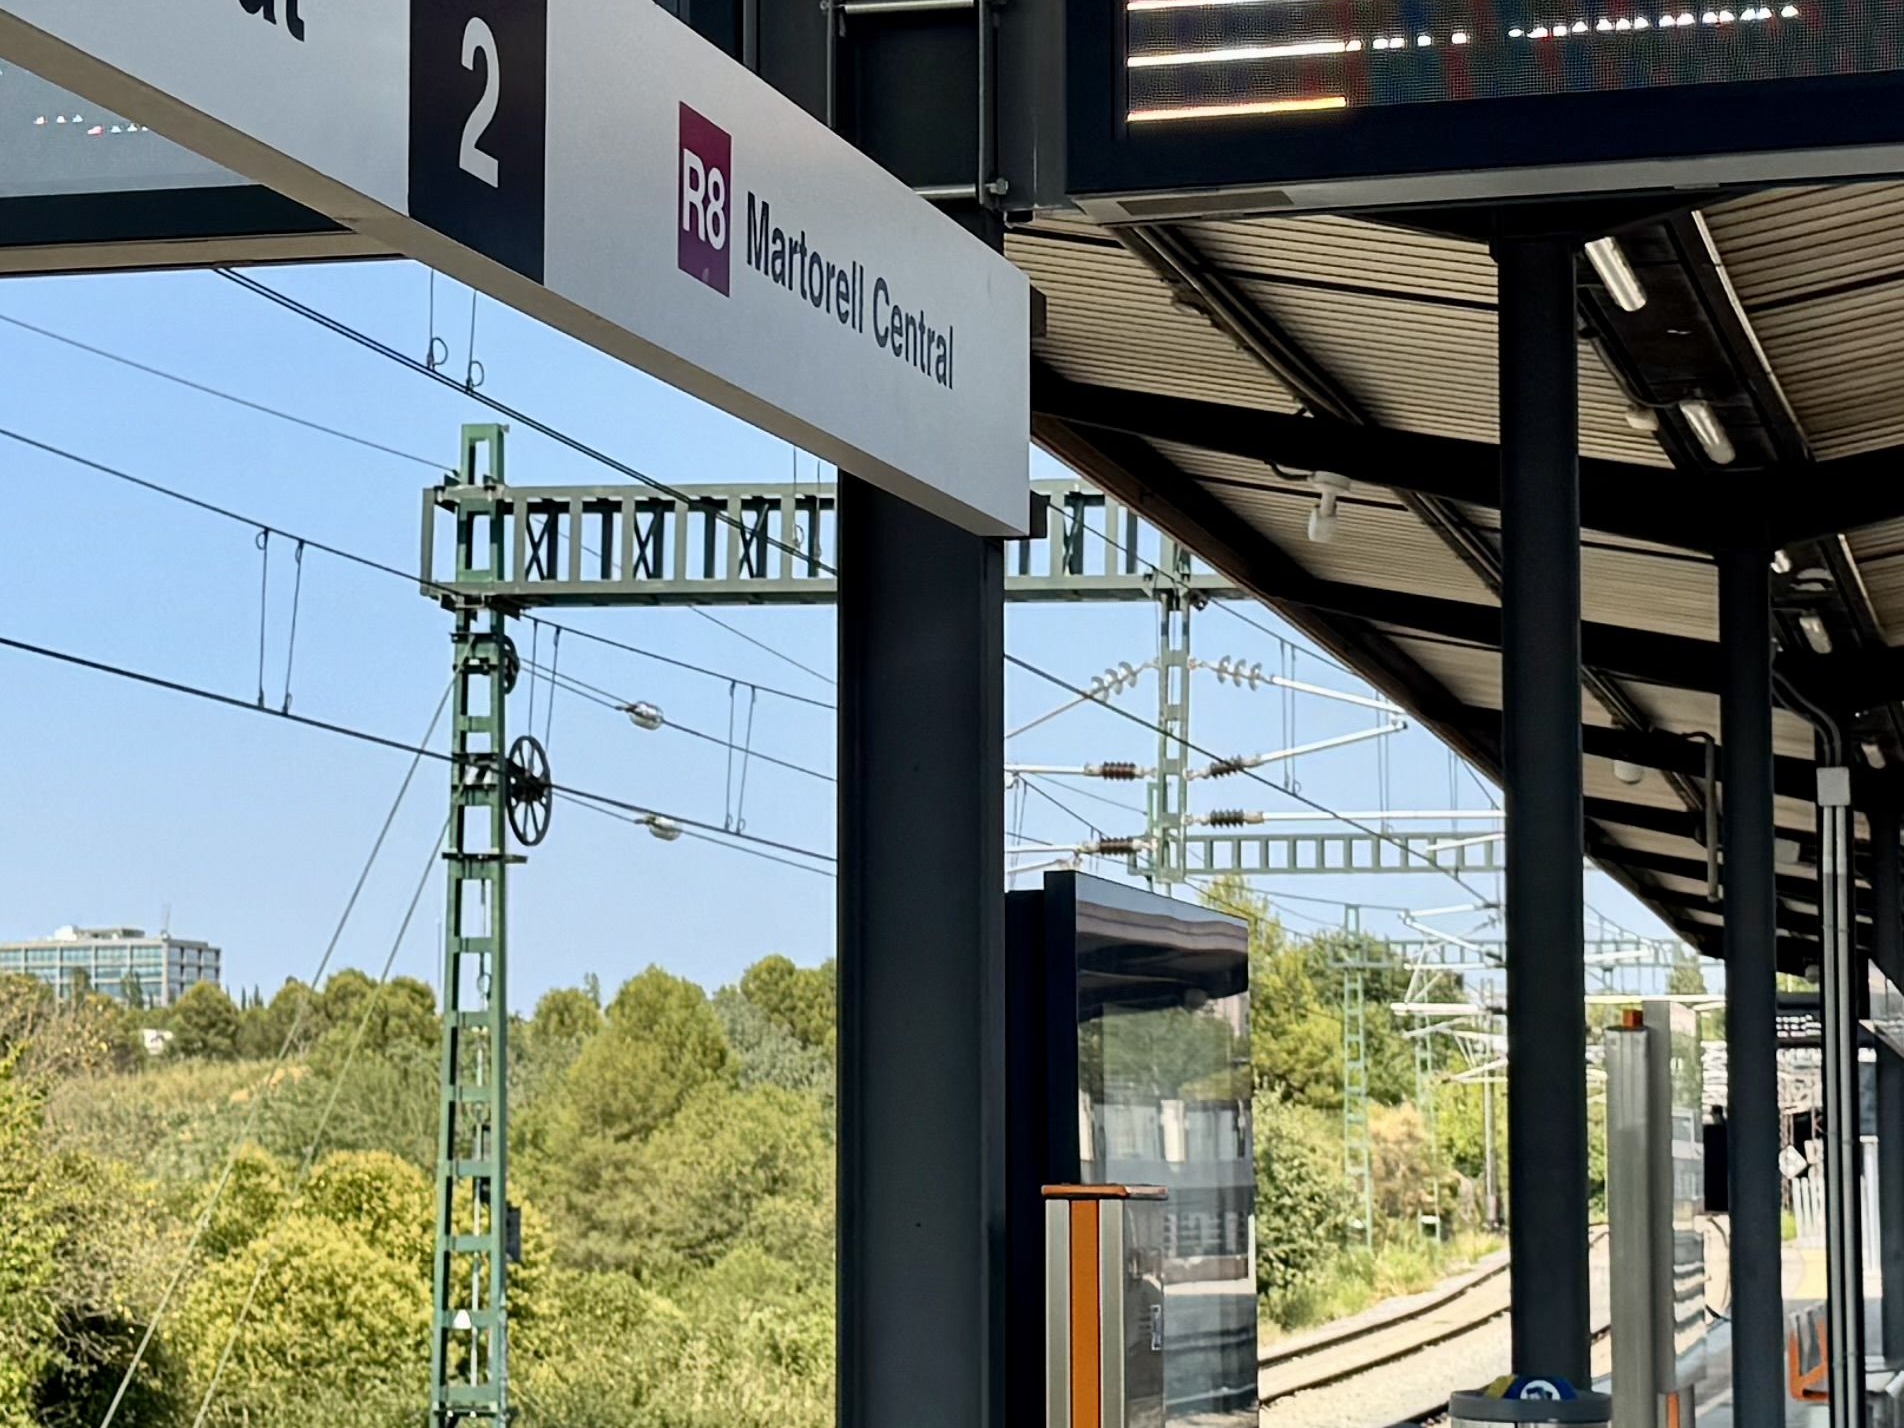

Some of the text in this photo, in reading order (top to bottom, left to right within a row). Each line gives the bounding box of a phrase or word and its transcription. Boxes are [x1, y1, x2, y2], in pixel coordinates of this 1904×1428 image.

[458, 15, 500, 188] 2
[682, 148, 954, 390] R8 Martorell Central
